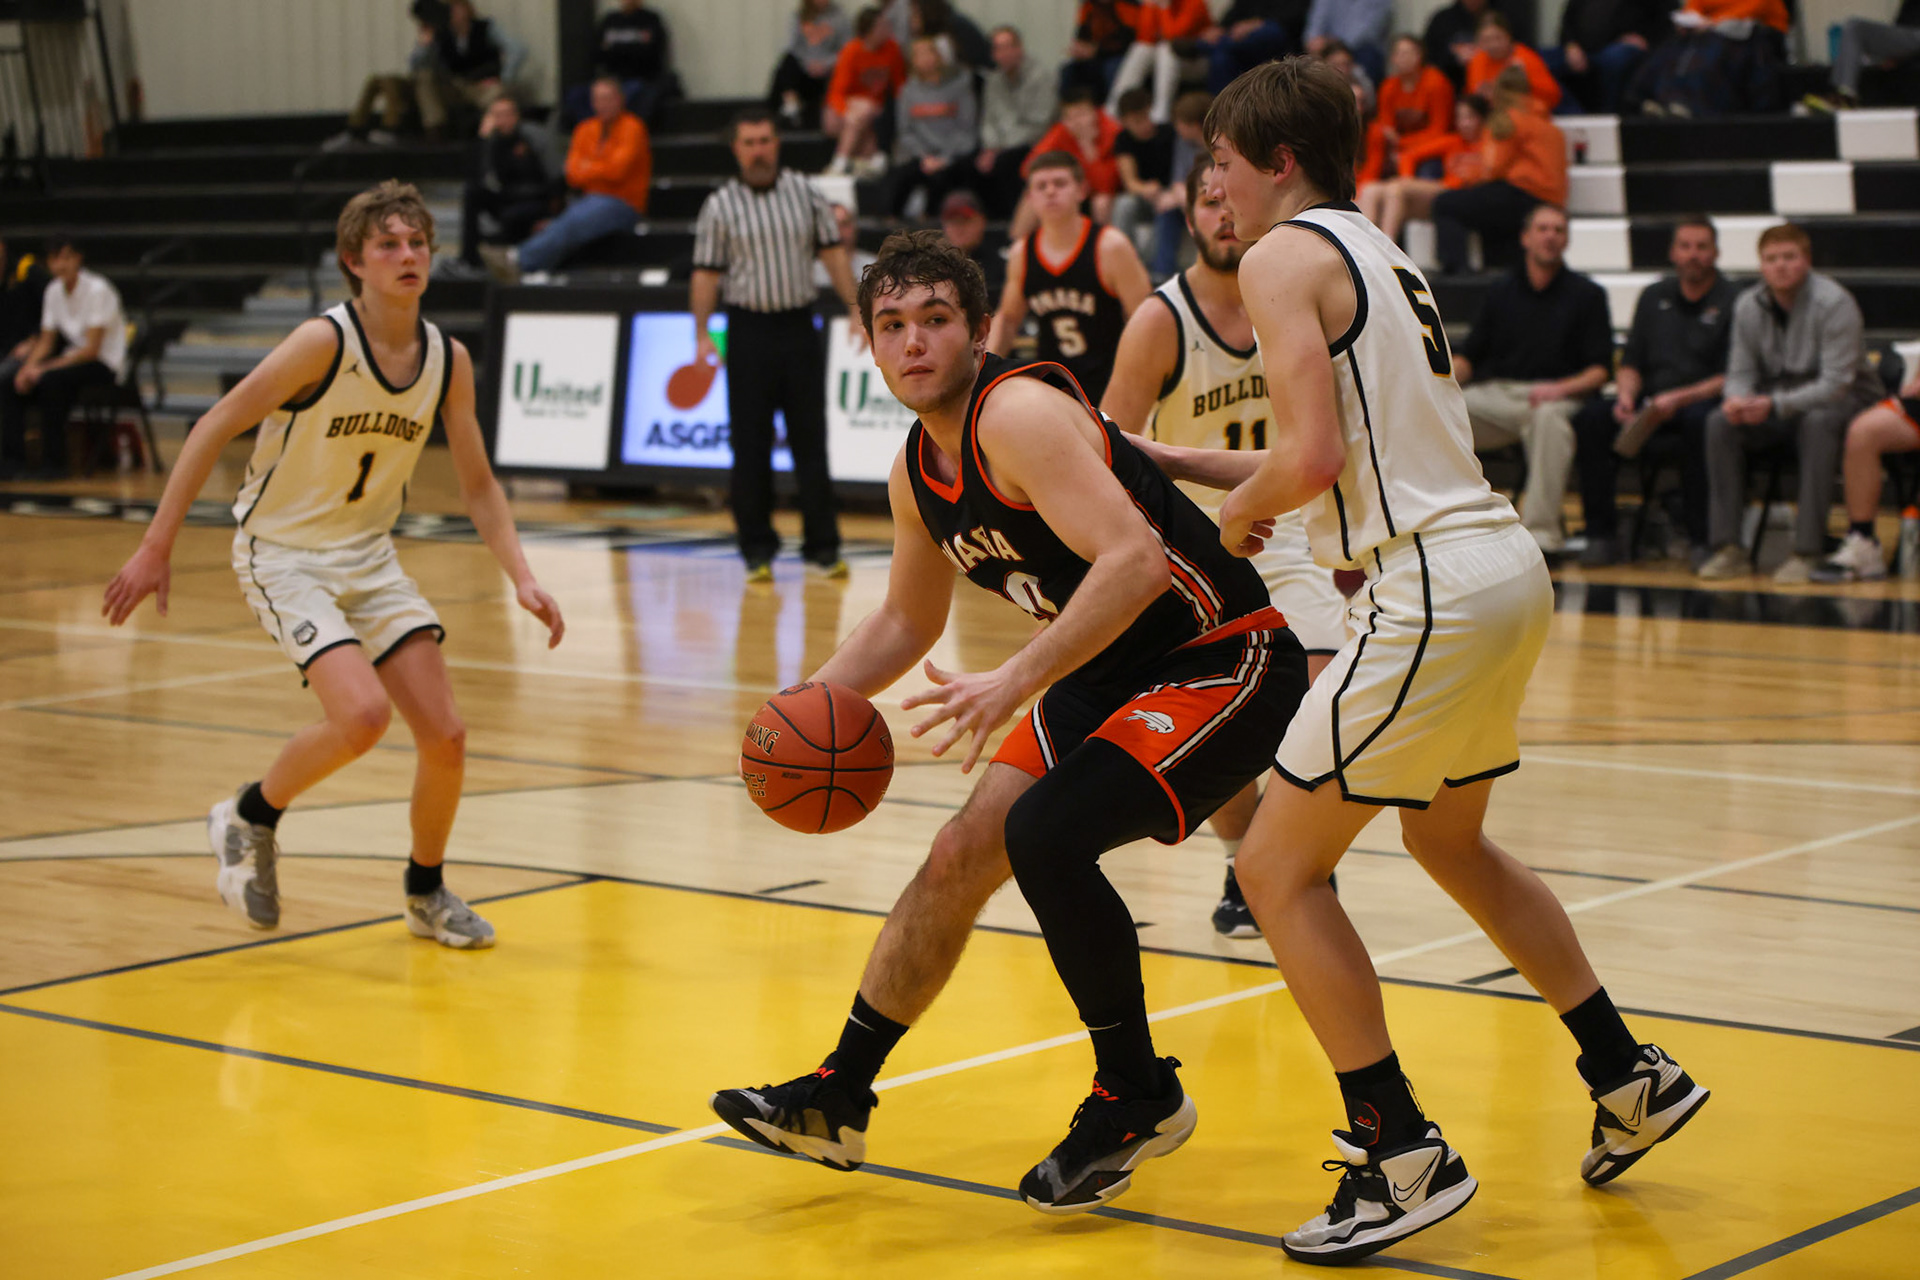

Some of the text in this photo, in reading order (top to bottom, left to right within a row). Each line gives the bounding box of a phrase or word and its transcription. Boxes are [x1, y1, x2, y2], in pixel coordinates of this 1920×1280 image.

[1051, 316, 1088, 358] 5
[1390, 265, 1451, 378] 5
[513, 362, 604, 406] United
[1192, 374, 1270, 418] BULLD
[1222, 417, 1268, 452] 11
[345, 450, 376, 505] 1
